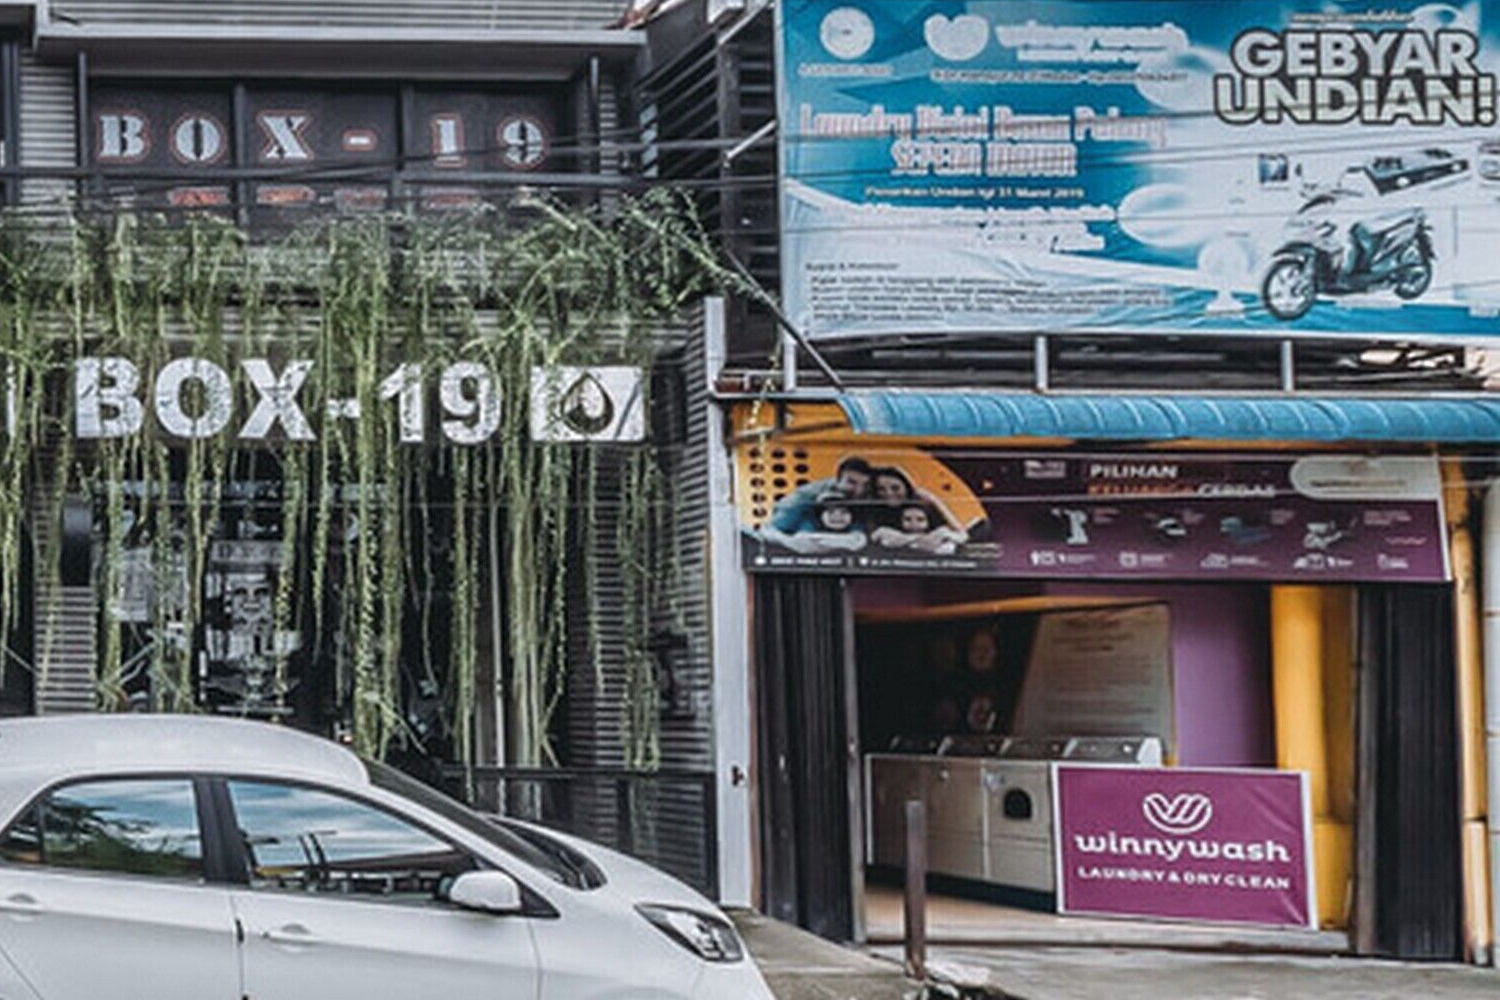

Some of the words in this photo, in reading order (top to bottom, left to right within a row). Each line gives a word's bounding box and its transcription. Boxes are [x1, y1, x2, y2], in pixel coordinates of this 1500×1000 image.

[1231, 29, 1478, 76] GEBYAR
[1214, 74, 1497, 126] UNDIAN!
[1090, 464, 1179, 479] PILIHAN
[1074, 832, 1291, 863] winnywash
[1077, 866, 1165, 882] LAUNDRY
[1168, 870, 1181, 883] &
[1223, 872, 1291, 889] CLEAN
